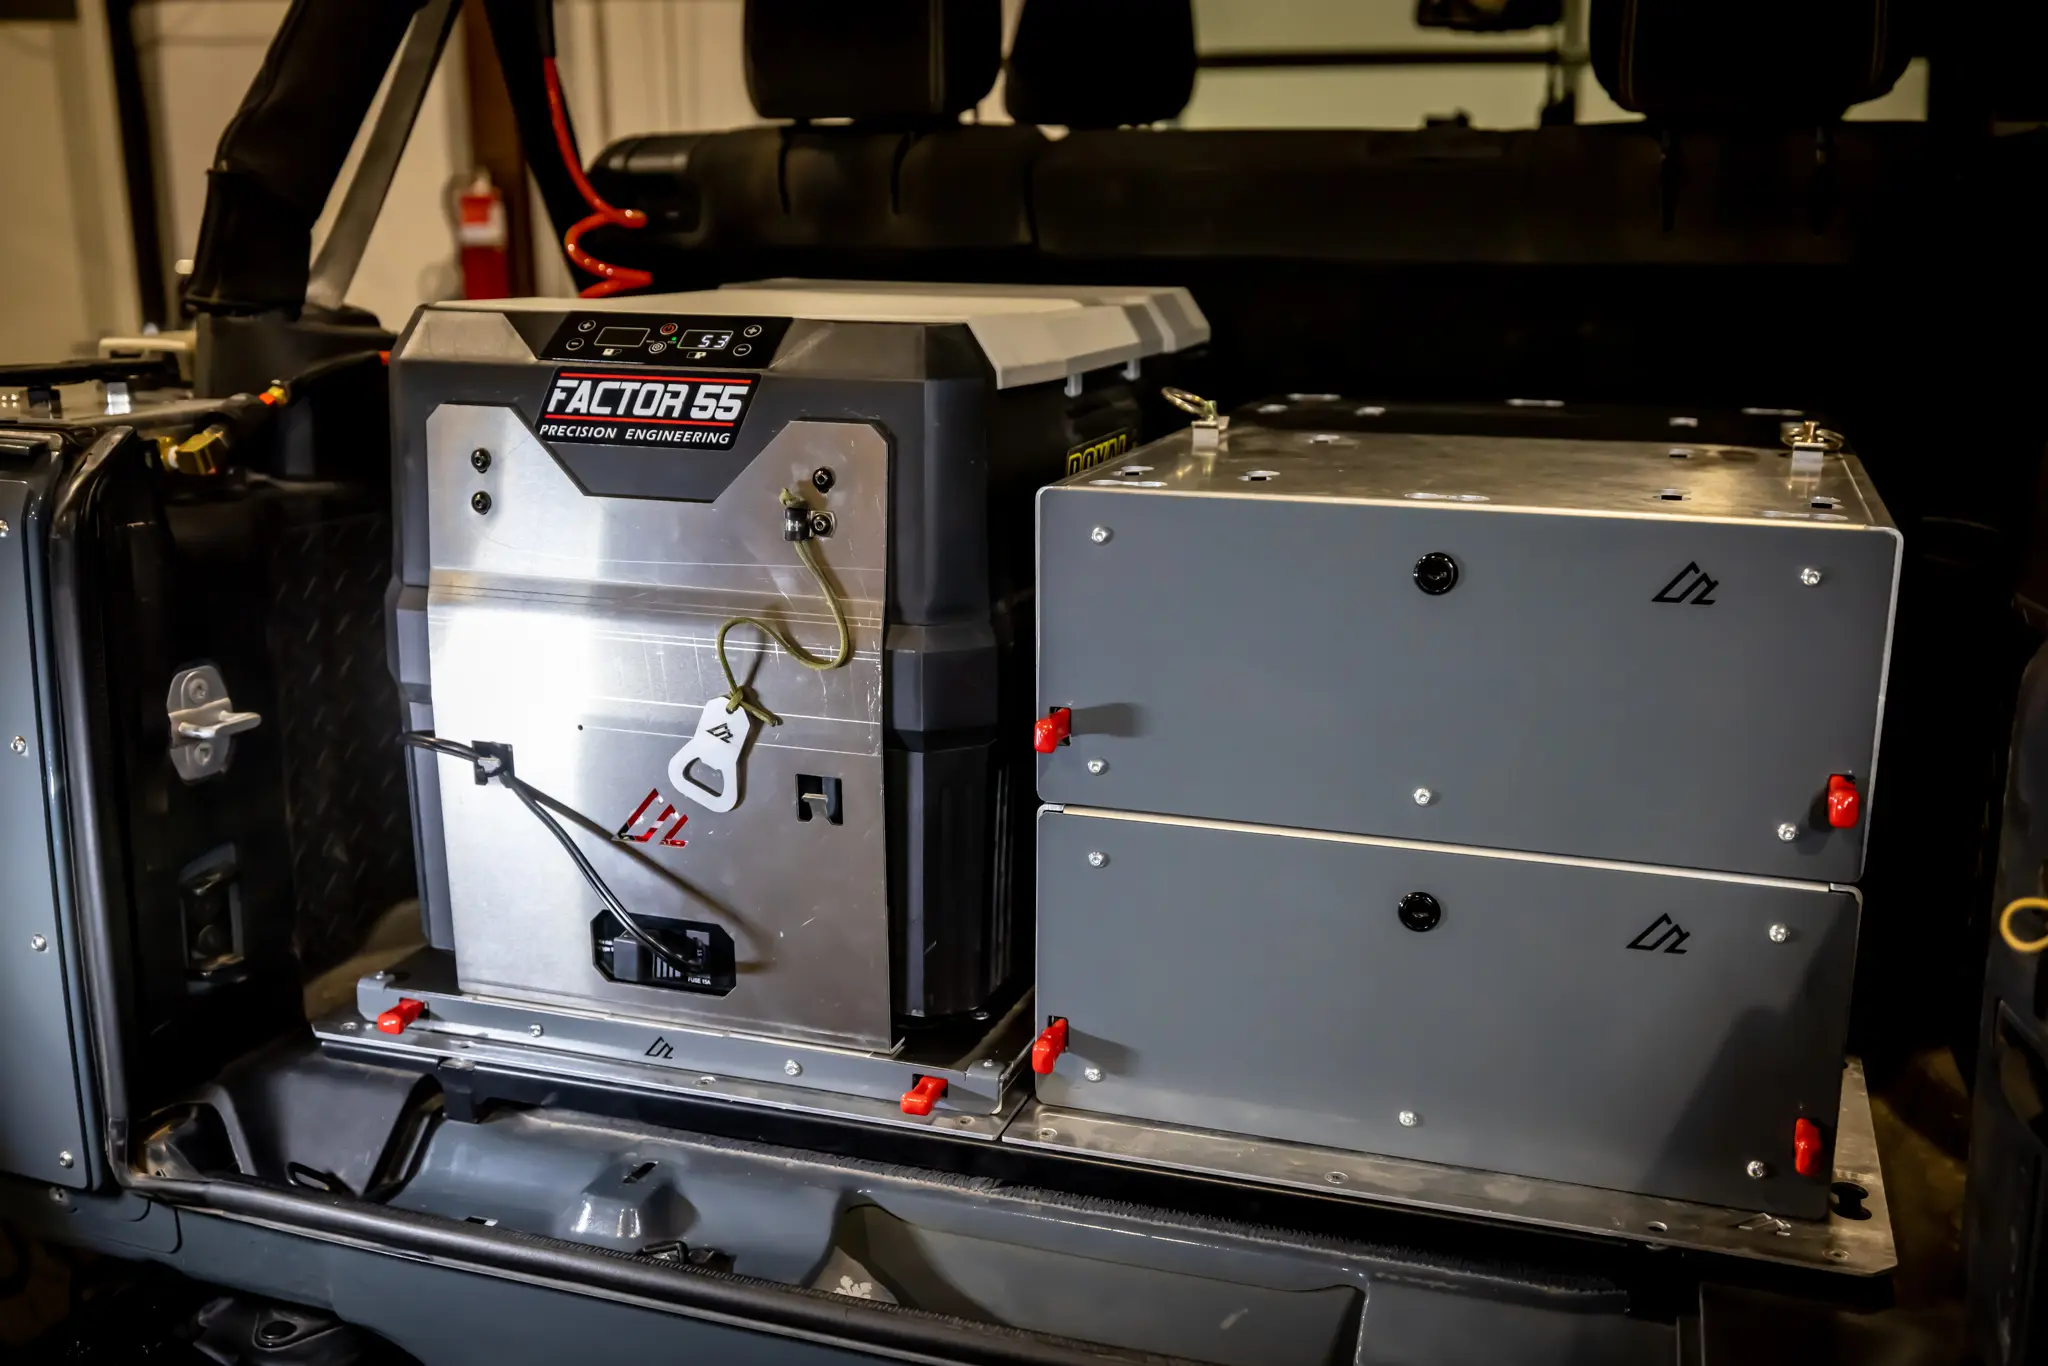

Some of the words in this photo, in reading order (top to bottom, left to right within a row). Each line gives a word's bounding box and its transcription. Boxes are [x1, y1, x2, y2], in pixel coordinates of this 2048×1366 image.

[697, 334, 730, 348] 53
[546, 379, 689, 418] FACTOR
[689, 385, 749, 420] 55
[539, 424, 617, 439] PRECISION
[624, 428, 731, 444] ENGINEERING
